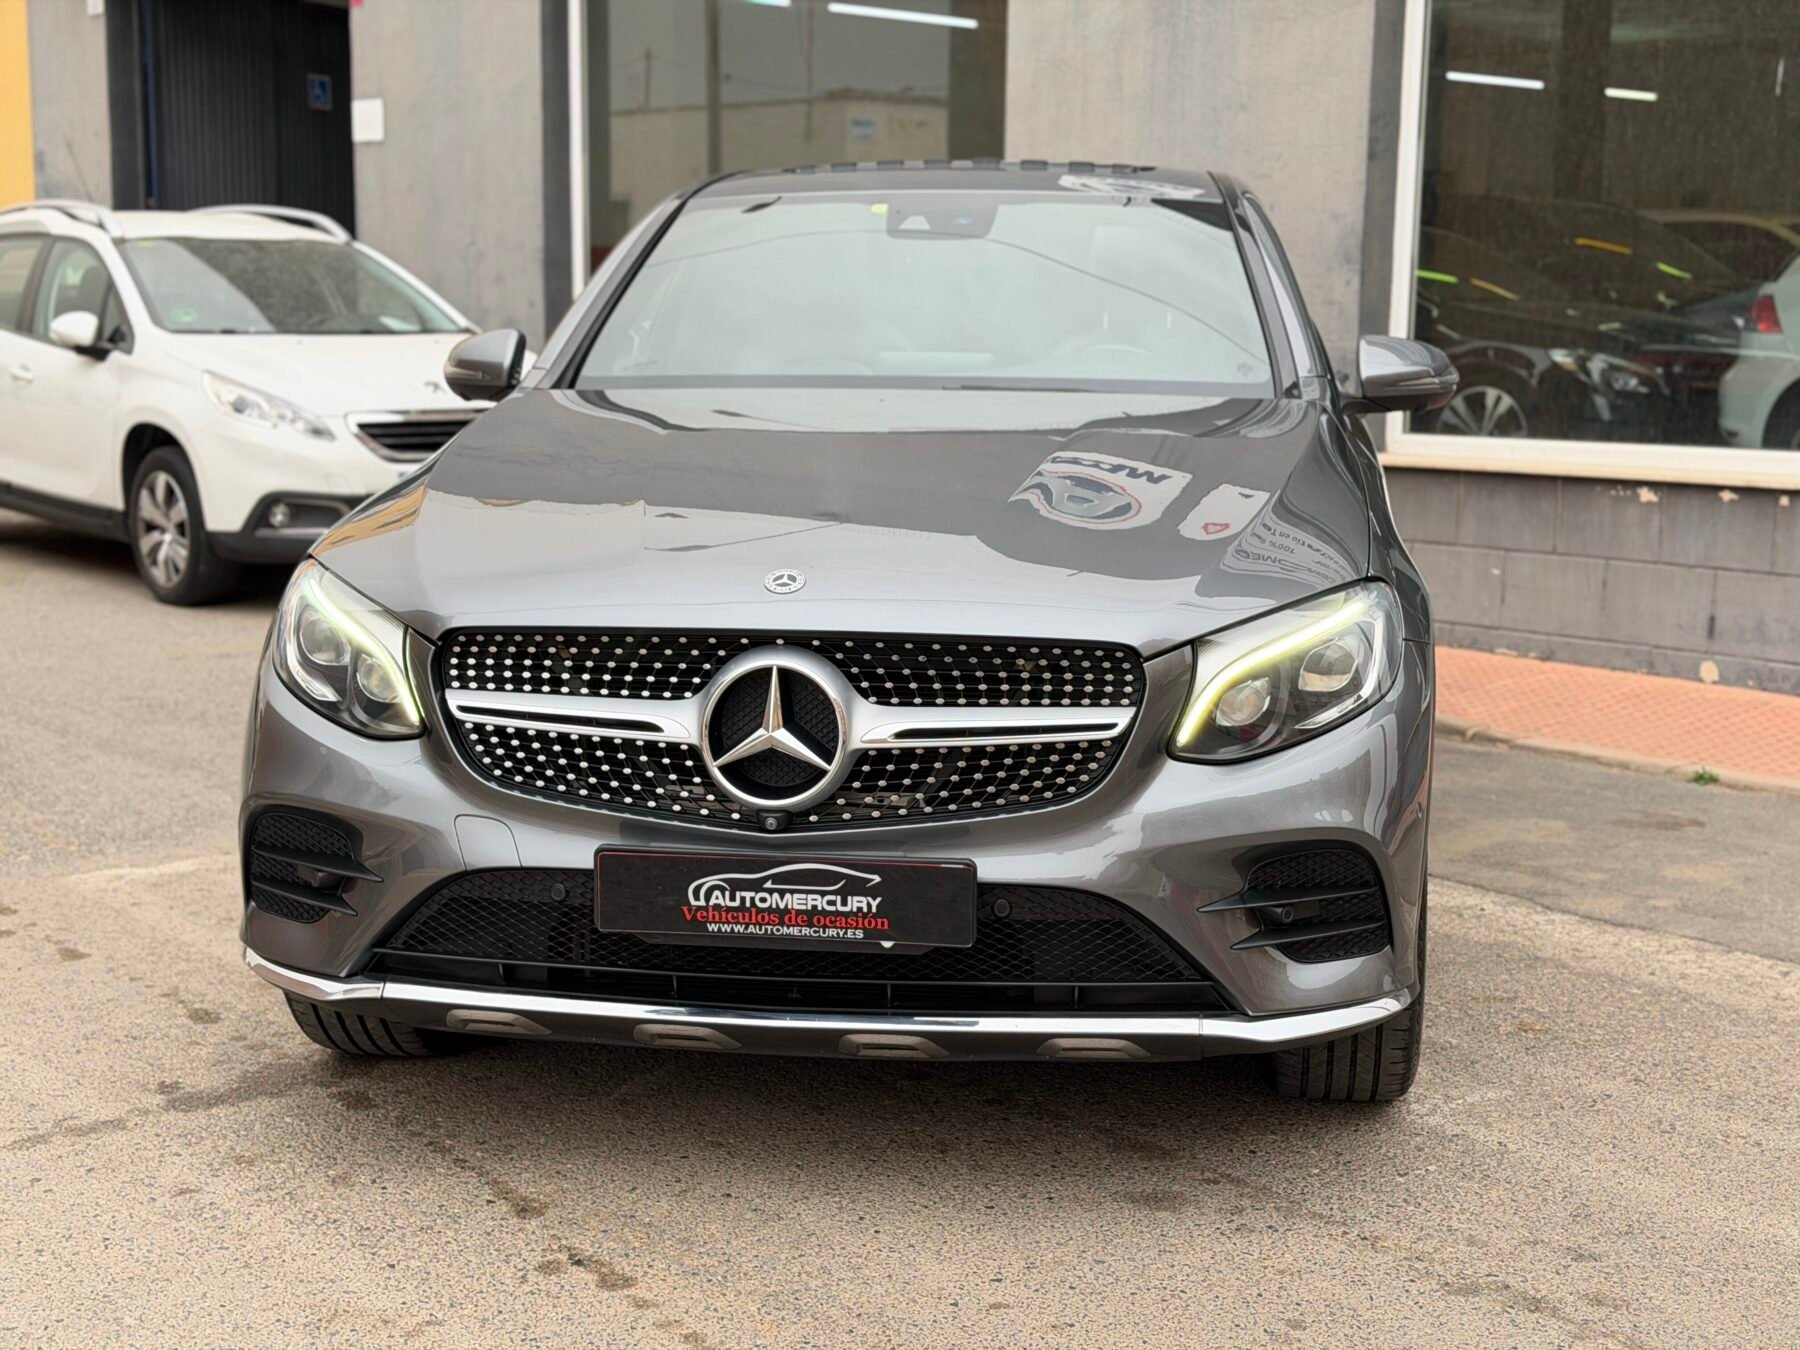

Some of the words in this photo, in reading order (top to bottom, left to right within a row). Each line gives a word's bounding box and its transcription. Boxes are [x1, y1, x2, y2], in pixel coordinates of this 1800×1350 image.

[708, 889, 882, 913] AUTOMERCURY
[681, 905, 779, 925] Vehículos
[784, 909, 808, 926] de
[813, 912, 889, 929] ocasión
[707, 922, 864, 939] WWW.AUTOMERCURY.ES
